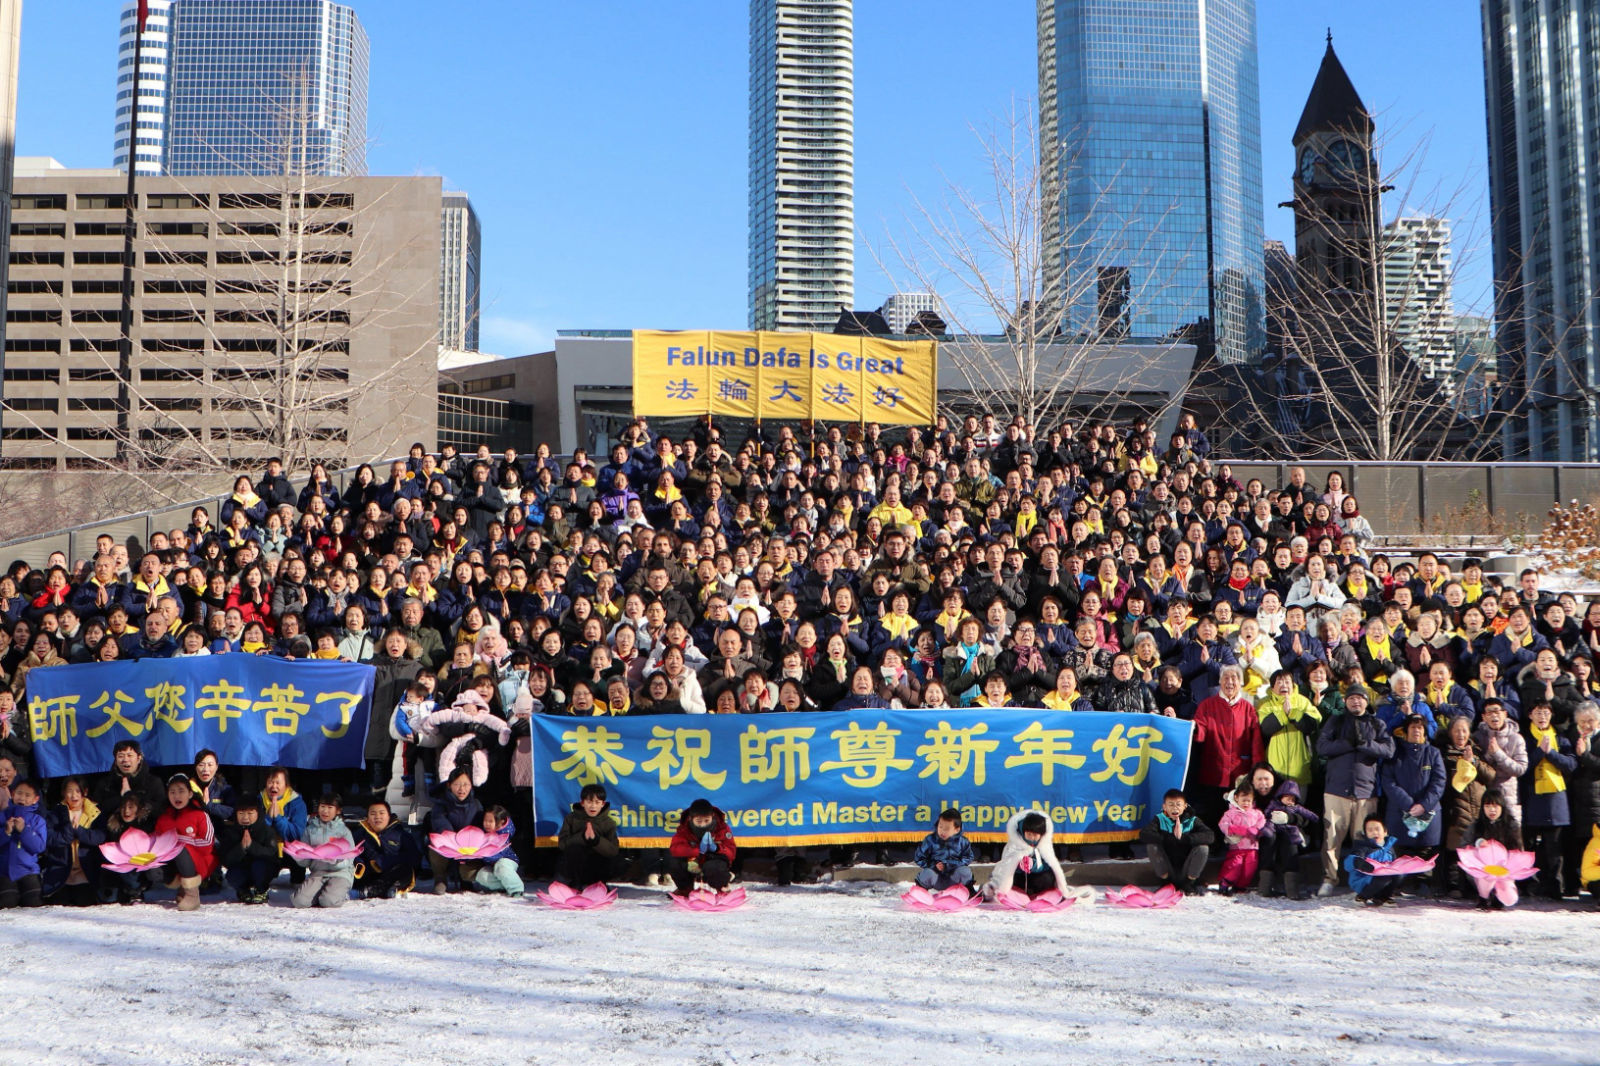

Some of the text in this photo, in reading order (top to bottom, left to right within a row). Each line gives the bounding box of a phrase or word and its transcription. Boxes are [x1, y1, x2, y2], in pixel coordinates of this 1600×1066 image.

[667, 345, 904, 375] Falun Dafa Is Great
[665, 378, 905, 408] 法輪大法好
[28, 678, 363, 746] 師父您辛苦了
[550, 721, 1173, 791] 恭祝師尊新年好
[570, 804, 684, 832] shing
[724, 803, 804, 828] vered
[812, 801, 908, 826] Master
[914, 805, 932, 822] a
[1093, 799, 1146, 823] Year
